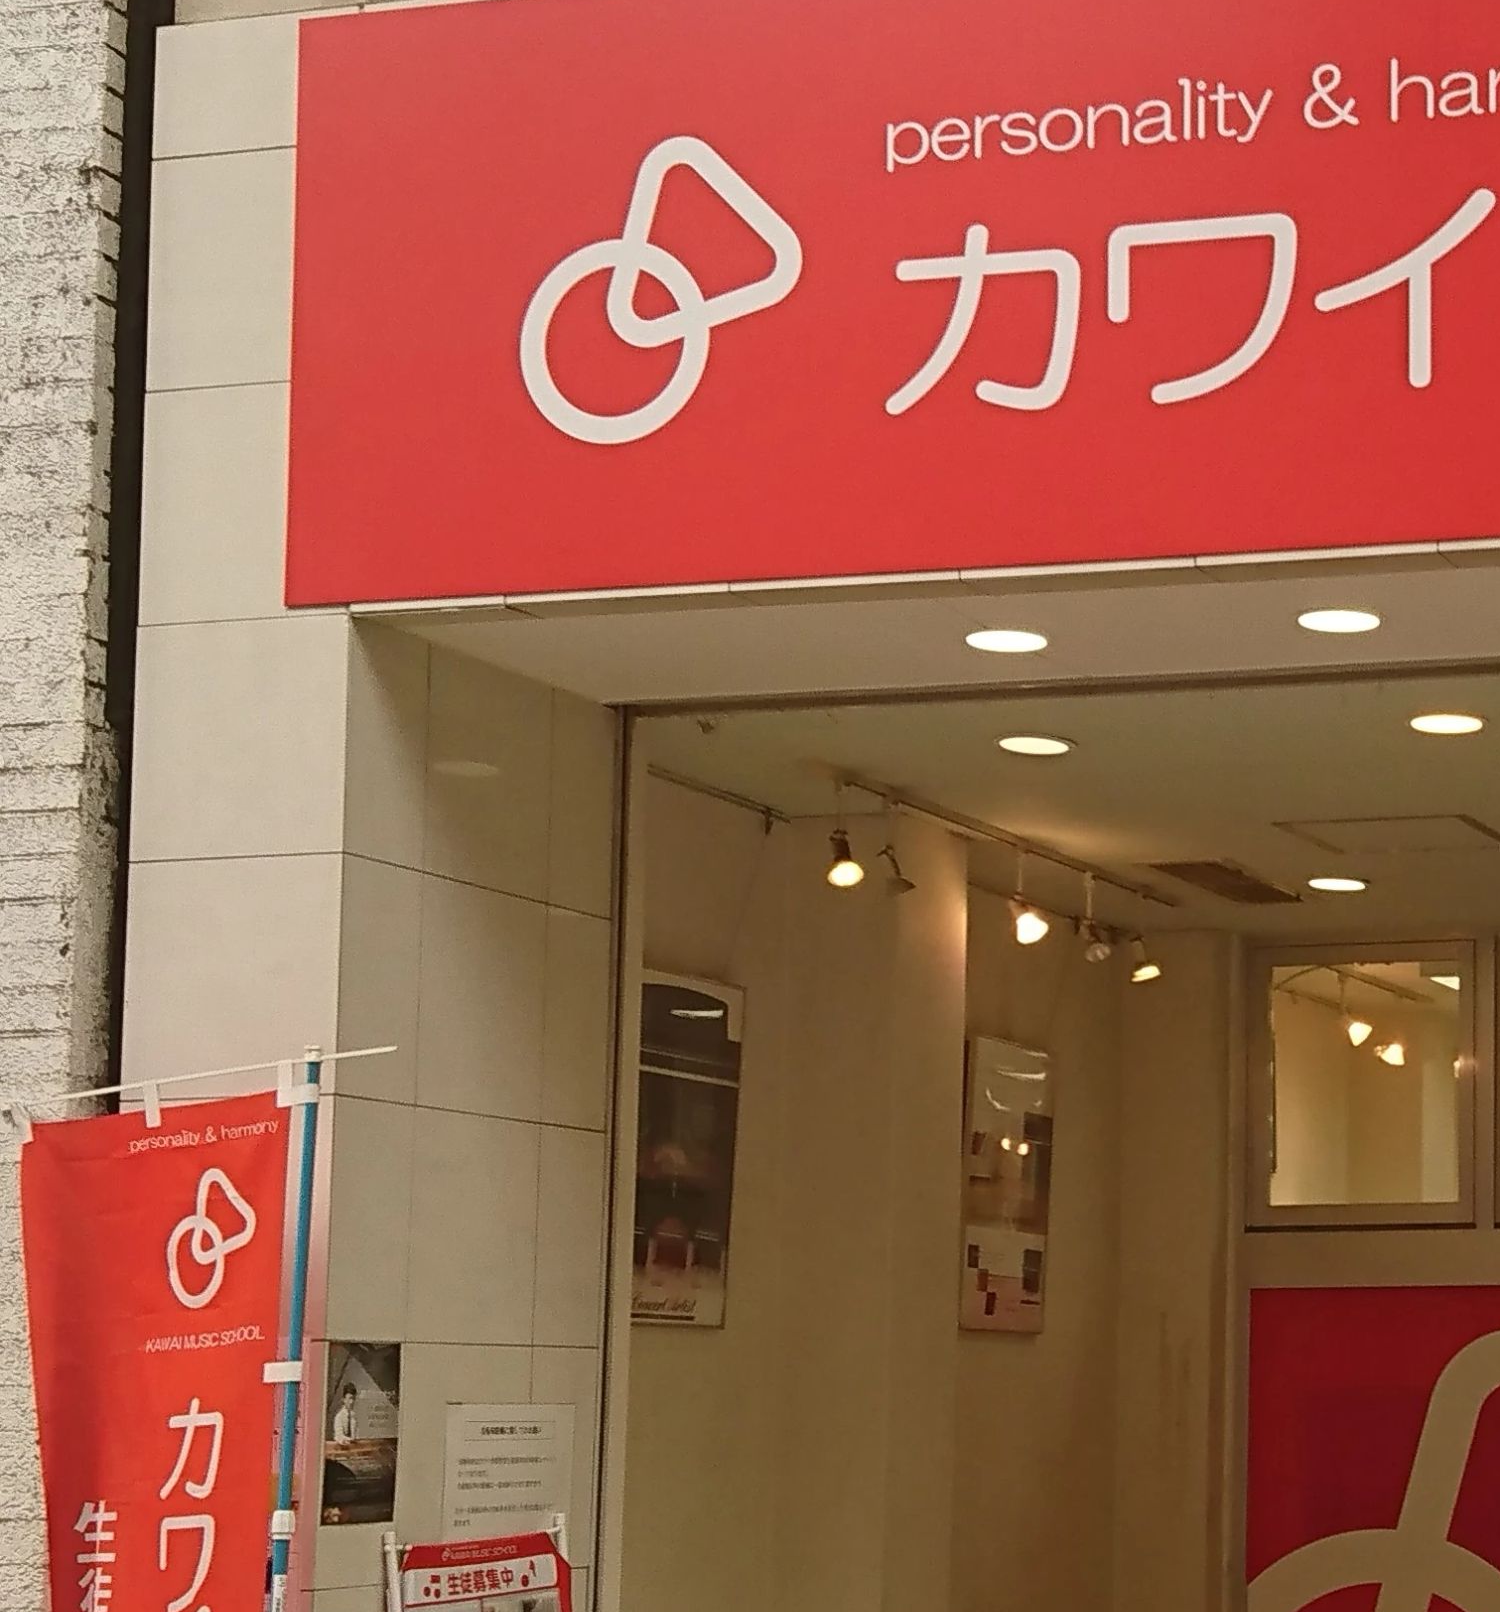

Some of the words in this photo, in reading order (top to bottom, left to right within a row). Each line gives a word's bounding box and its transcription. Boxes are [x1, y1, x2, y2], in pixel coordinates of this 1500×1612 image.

[885, 77, 1274, 172] personality
[1302, 64, 1359, 129] &
[127, 1132, 201, 1154] personality
[205, 1126, 218, 1144] &
[220, 1119, 280, 1139] harmony
[146, 1338, 183, 1354] KAWAI
[447, 1567, 514, 1595] 生徒募集中
